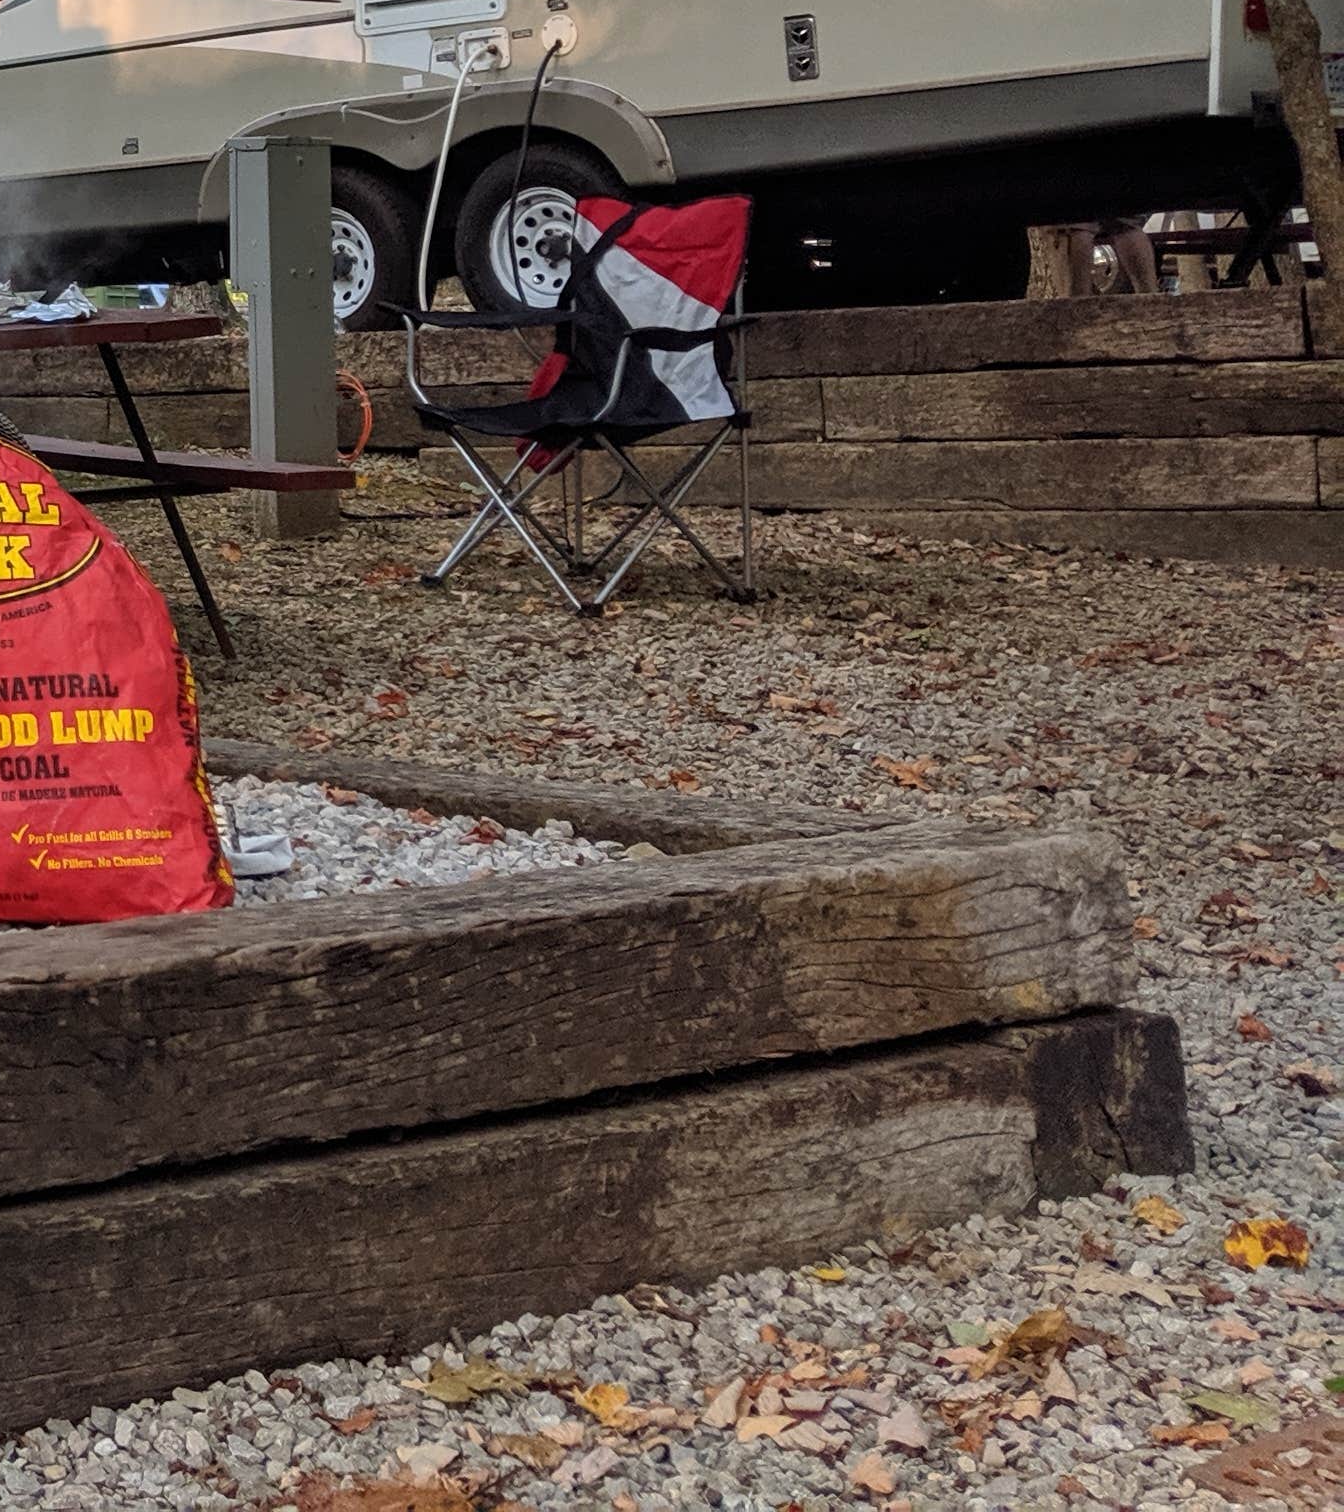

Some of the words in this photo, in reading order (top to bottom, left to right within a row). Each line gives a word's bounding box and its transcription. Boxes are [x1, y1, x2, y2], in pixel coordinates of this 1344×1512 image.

[0, 601, 54, 622] AMERICA
[49, 708, 154, 745] LUMP
[69, 784, 123, 798] NATURAL
[28, 833, 45, 845] Pro
[46, 832, 68, 844] Fuel
[69, 831, 83, 843] for
[84, 830, 97, 842] all
[98, 830, 125, 842] Grills
[47, 859, 62, 870] No
[97, 856, 112, 868] No
[112, 854, 164, 867] Chemicals
